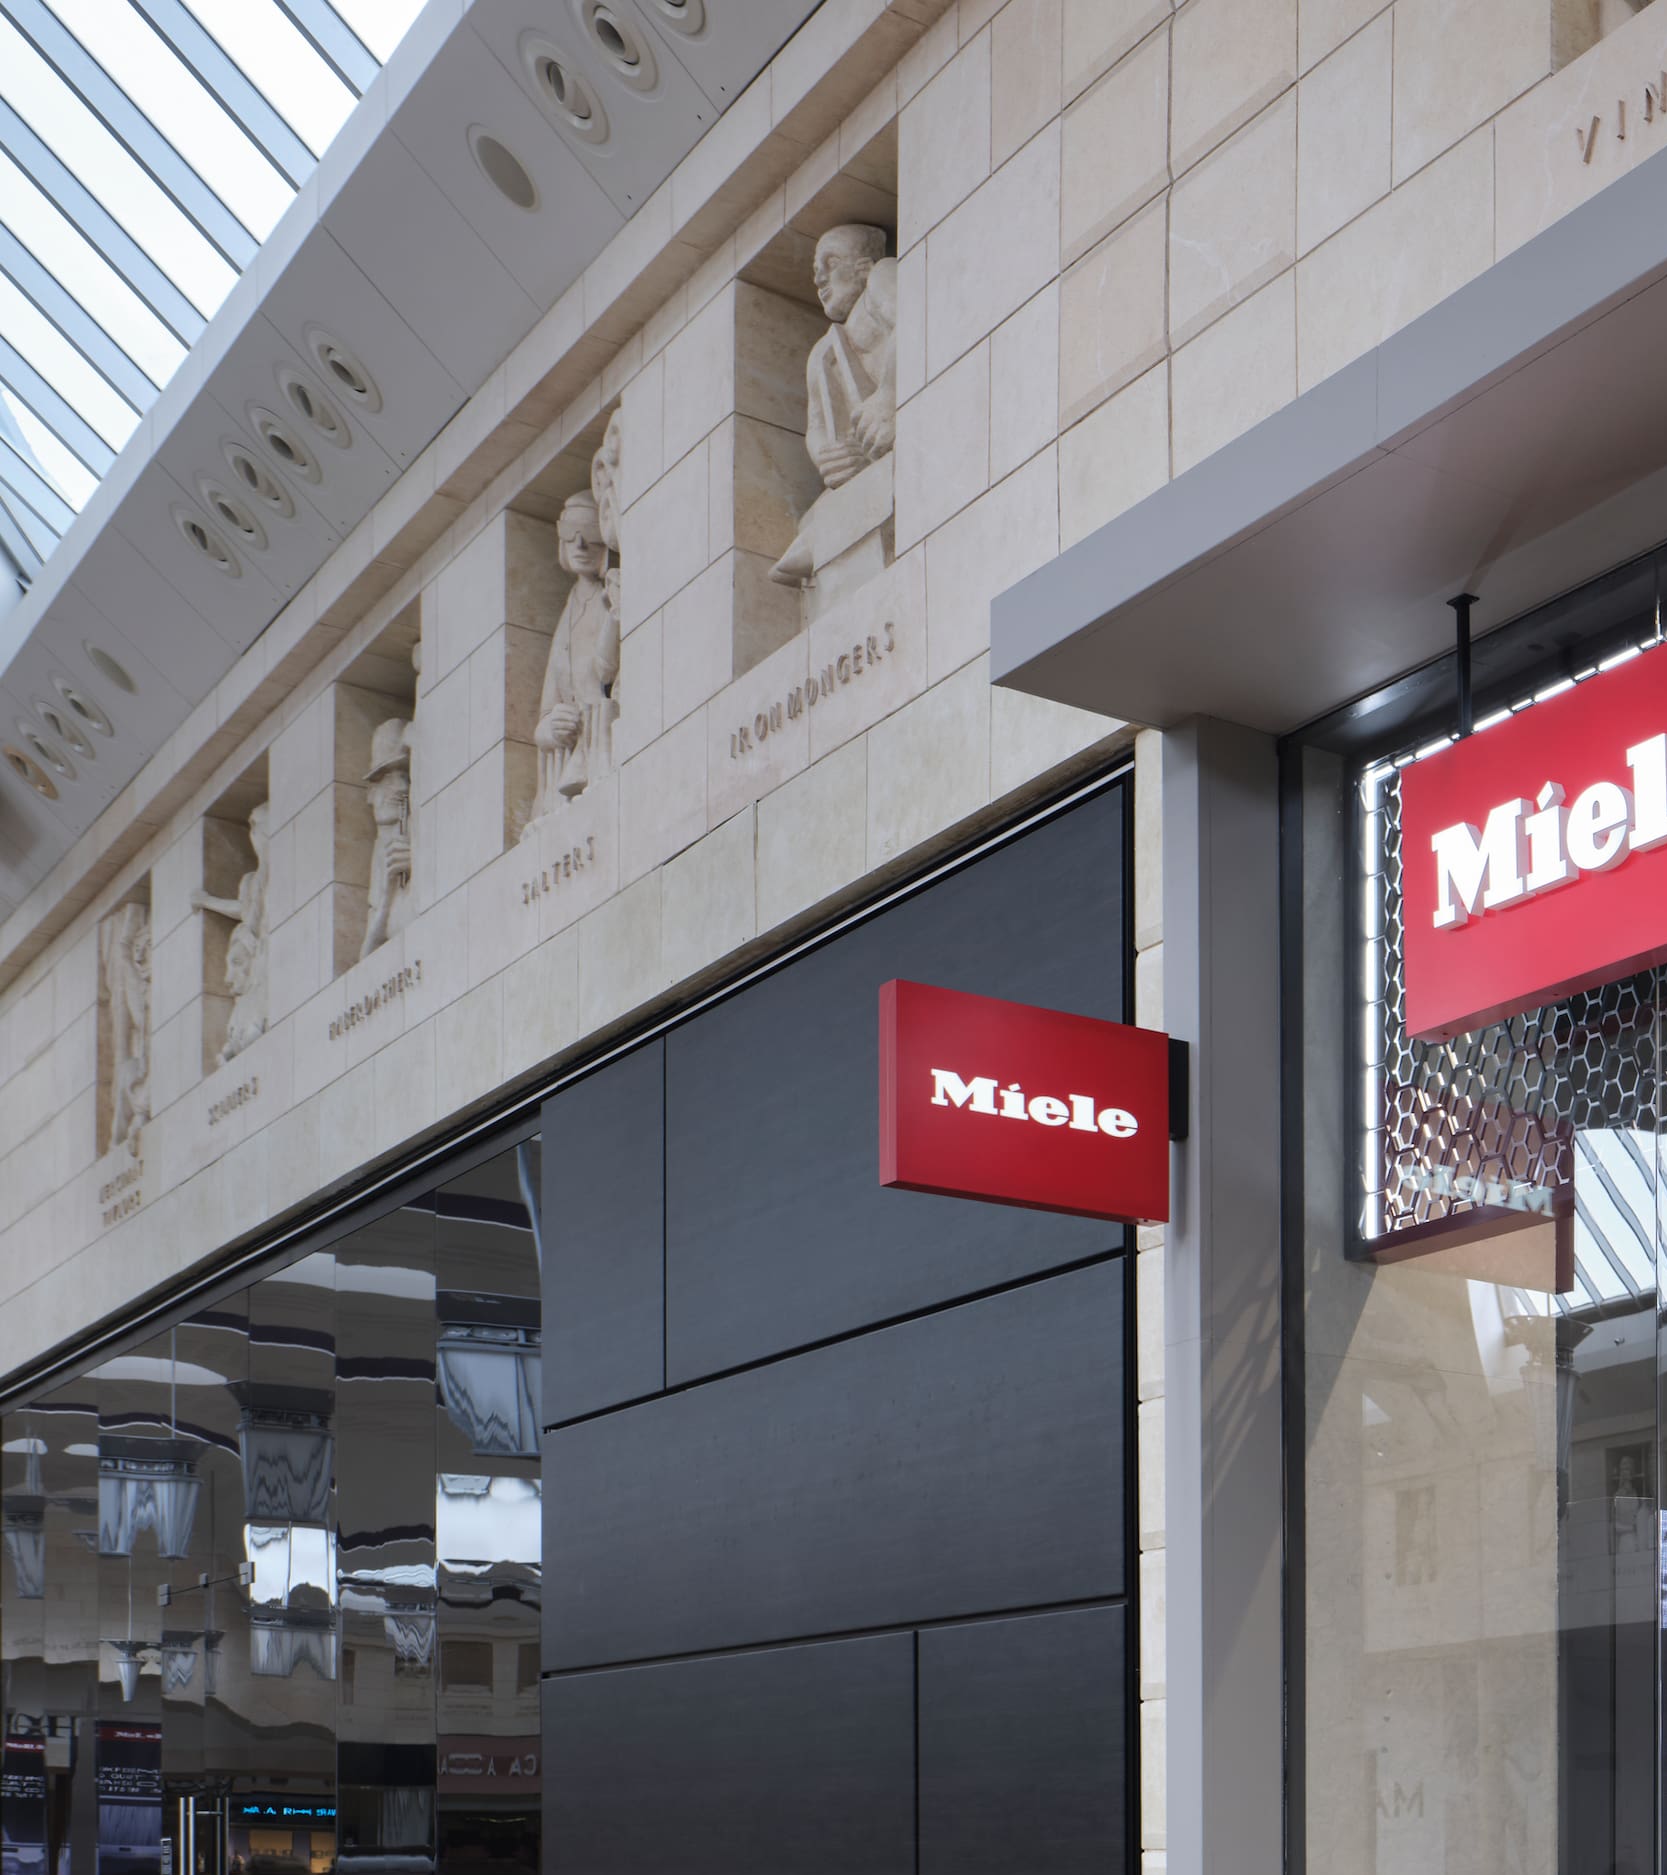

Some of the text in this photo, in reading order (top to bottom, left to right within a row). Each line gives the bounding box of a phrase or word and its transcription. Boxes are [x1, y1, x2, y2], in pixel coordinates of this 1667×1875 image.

[731, 621, 895, 760] IRONMONGERS
[522, 836, 595, 905] SALTERS
[931, 1067, 1139, 1138] Miele
